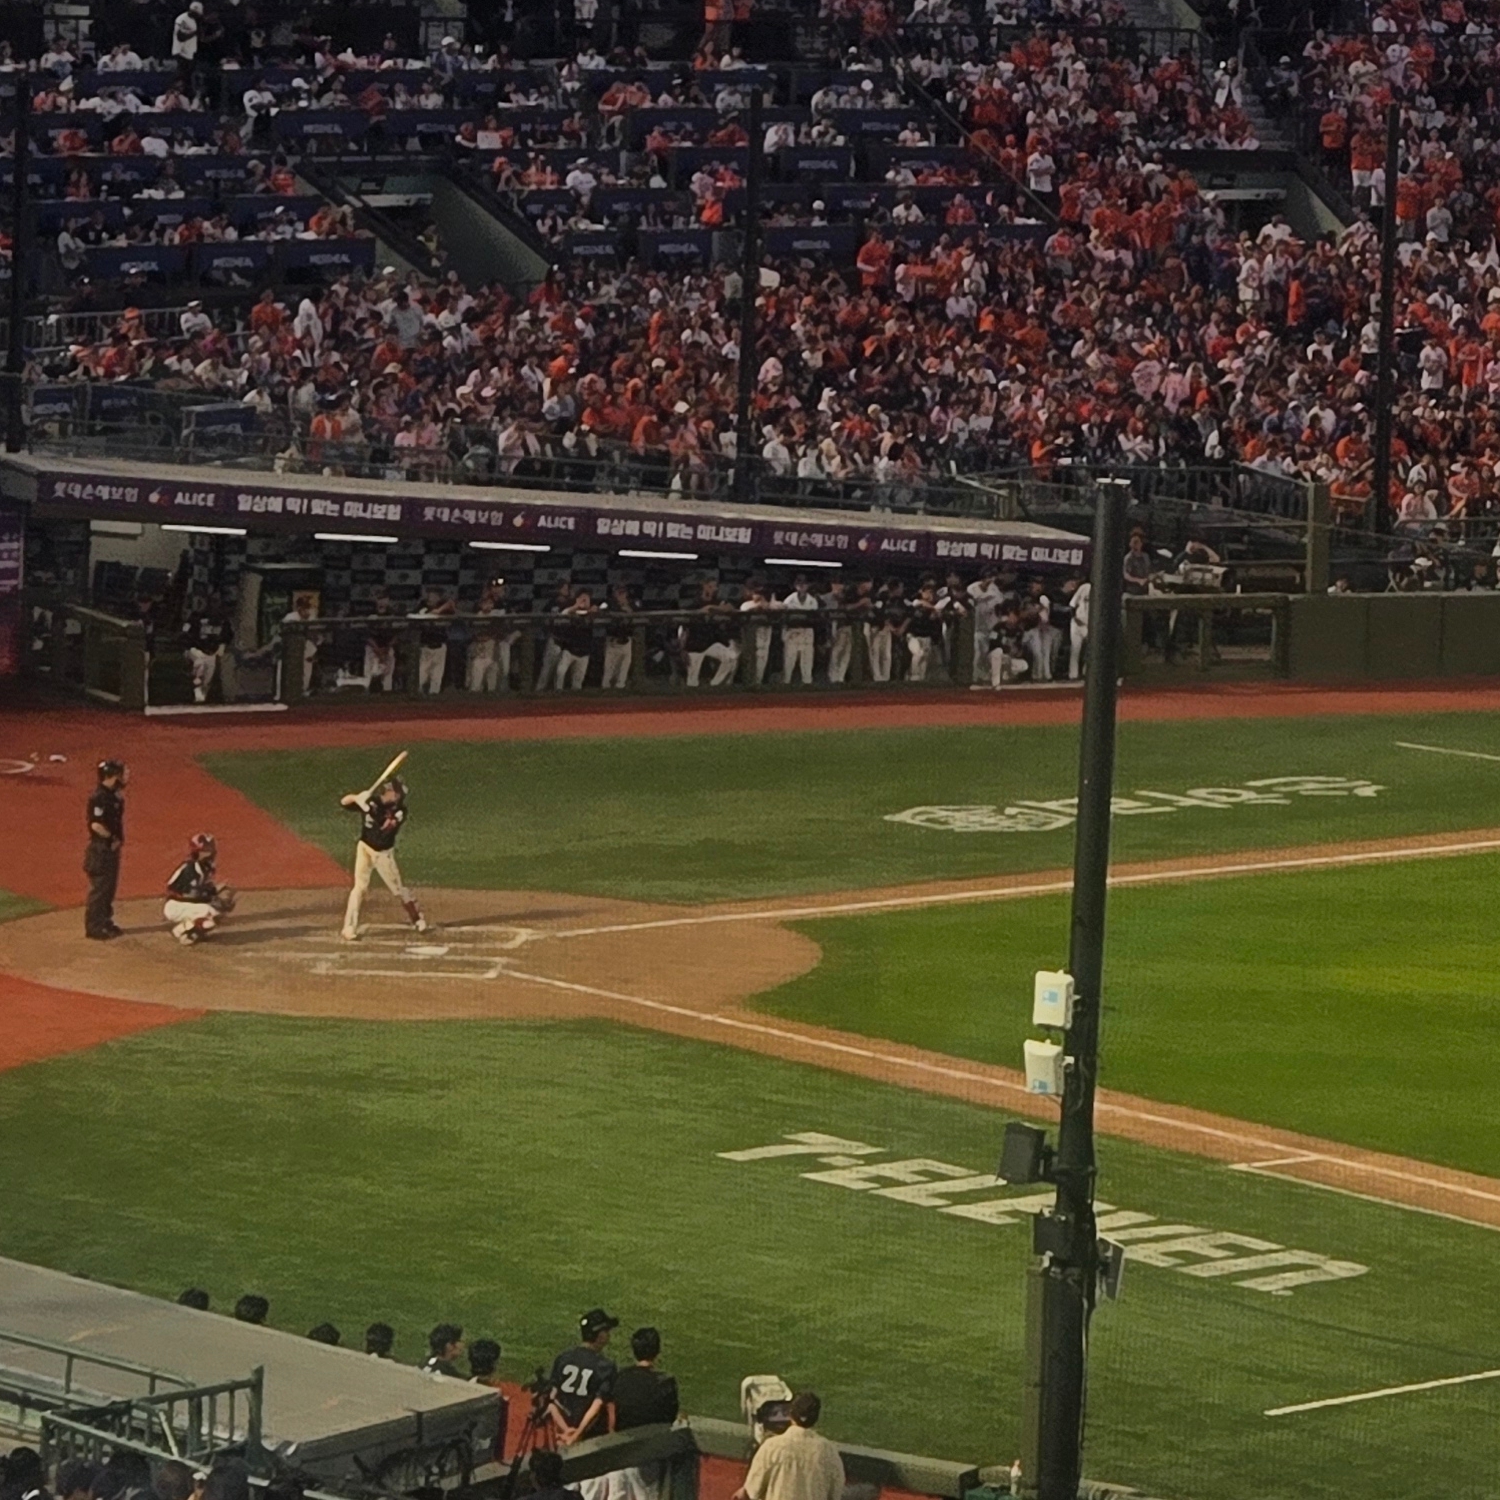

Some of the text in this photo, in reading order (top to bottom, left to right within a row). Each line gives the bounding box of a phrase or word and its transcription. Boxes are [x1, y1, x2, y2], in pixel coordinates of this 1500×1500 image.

[53, 481, 139, 502] 롯데손해보험
[174, 492, 215, 507] ALICE
[344, 501, 402, 521] 미니보험
[422, 507, 503, 526] 롯데손해보험
[537, 516, 575, 530] ALICE
[697, 524, 752, 544] 미니보험
[772, 531, 848, 550] 롯데손해보험
[881, 539, 917, 553] ALICE
[1031, 546, 1084, 566] 미니보험
[560, 1363, 594, 1397] 21
